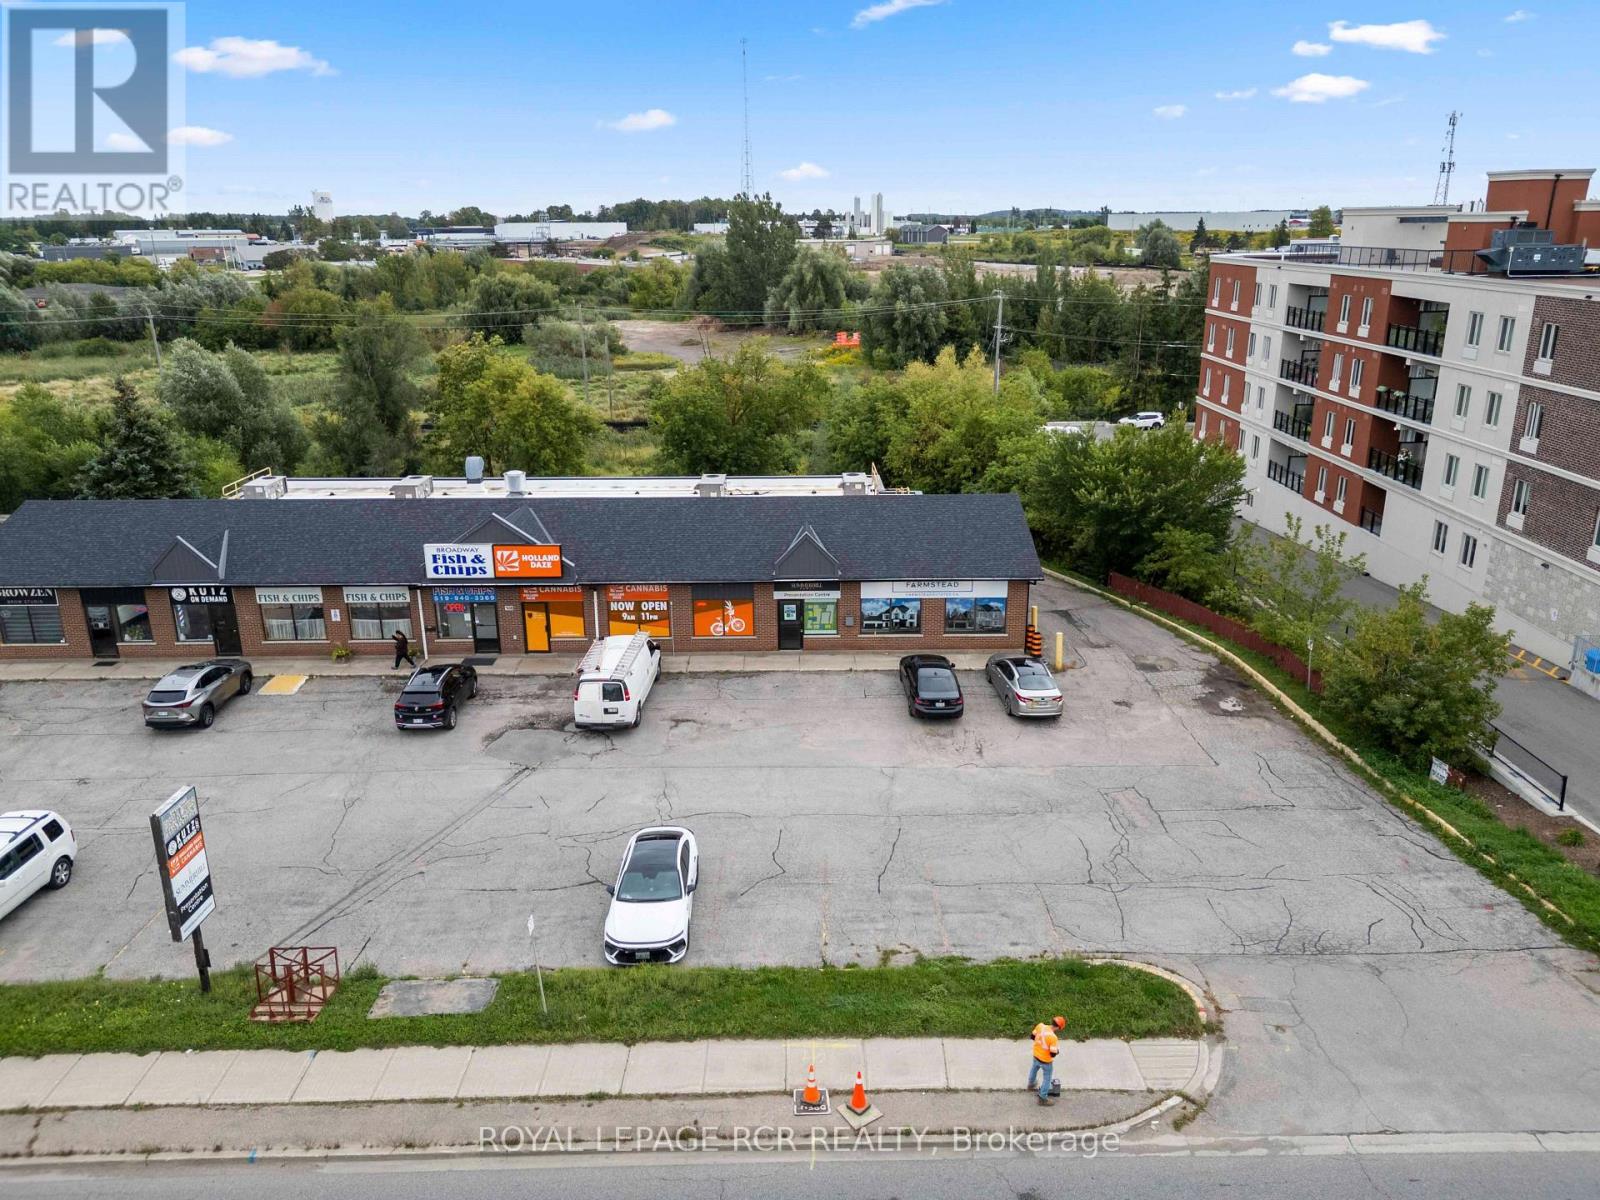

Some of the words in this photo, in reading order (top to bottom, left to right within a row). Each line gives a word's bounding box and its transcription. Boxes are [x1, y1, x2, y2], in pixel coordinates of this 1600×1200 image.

[431, 554, 467, 564] Fish
[470, 554, 488, 564] &
[530, 561, 552, 569] DAZE
[432, 565, 488, 577] Chips
[258, 594, 280, 602] FISH
[282, 594, 289, 602] &
[292, 594, 320, 602] CHIPS
[345, 593, 367, 602] FISH
[369, 593, 377, 601] &
[379, 592, 407, 601] CHIPS
[610, 601, 635, 611] NOW
[641, 601, 668, 611] OPEN
[176, 820, 196, 842] KUTZ
[180, 883, 208, 914] Presentation
[188, 894, 204, 913] Centre
